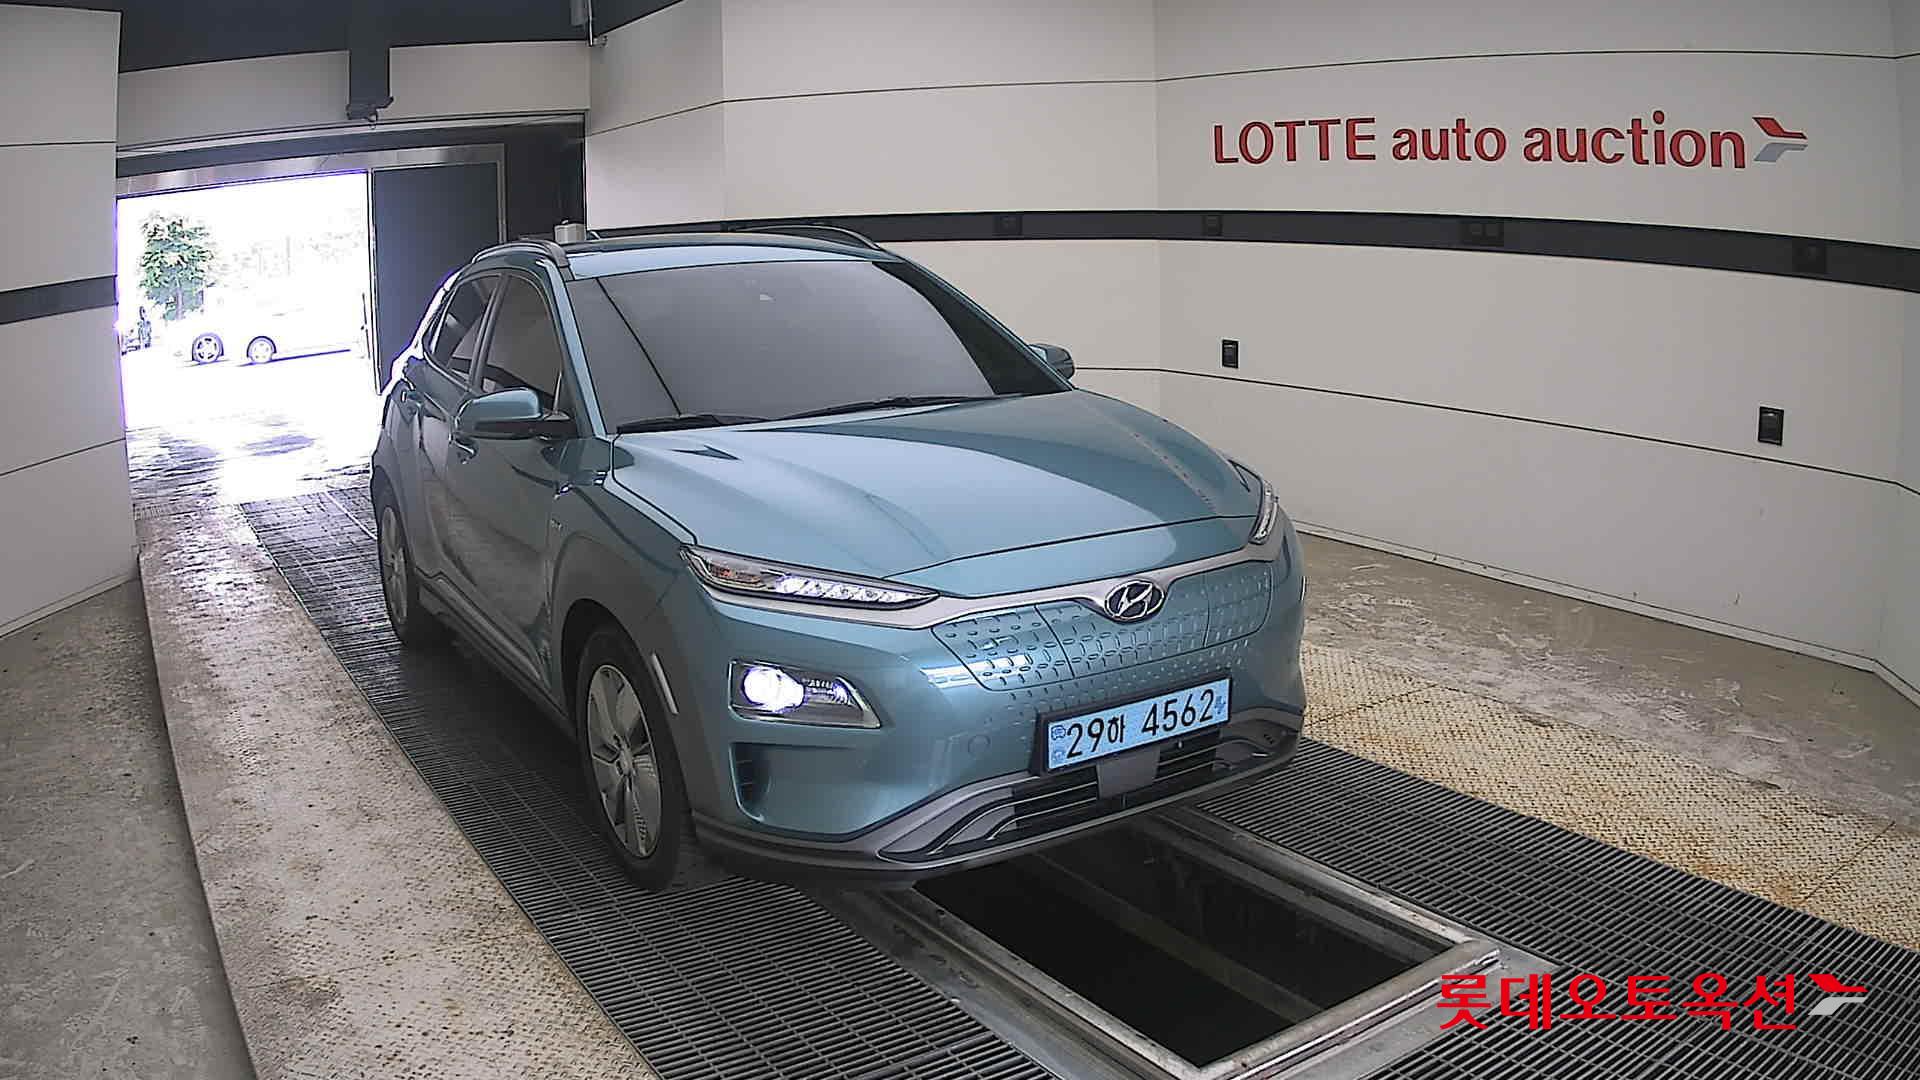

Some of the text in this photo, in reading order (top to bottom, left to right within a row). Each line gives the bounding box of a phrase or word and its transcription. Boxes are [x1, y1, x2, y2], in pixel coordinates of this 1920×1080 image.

[1214, 110, 1746, 169] LOTTE auto auction
[1066, 688, 1215, 759] 29하 4562
